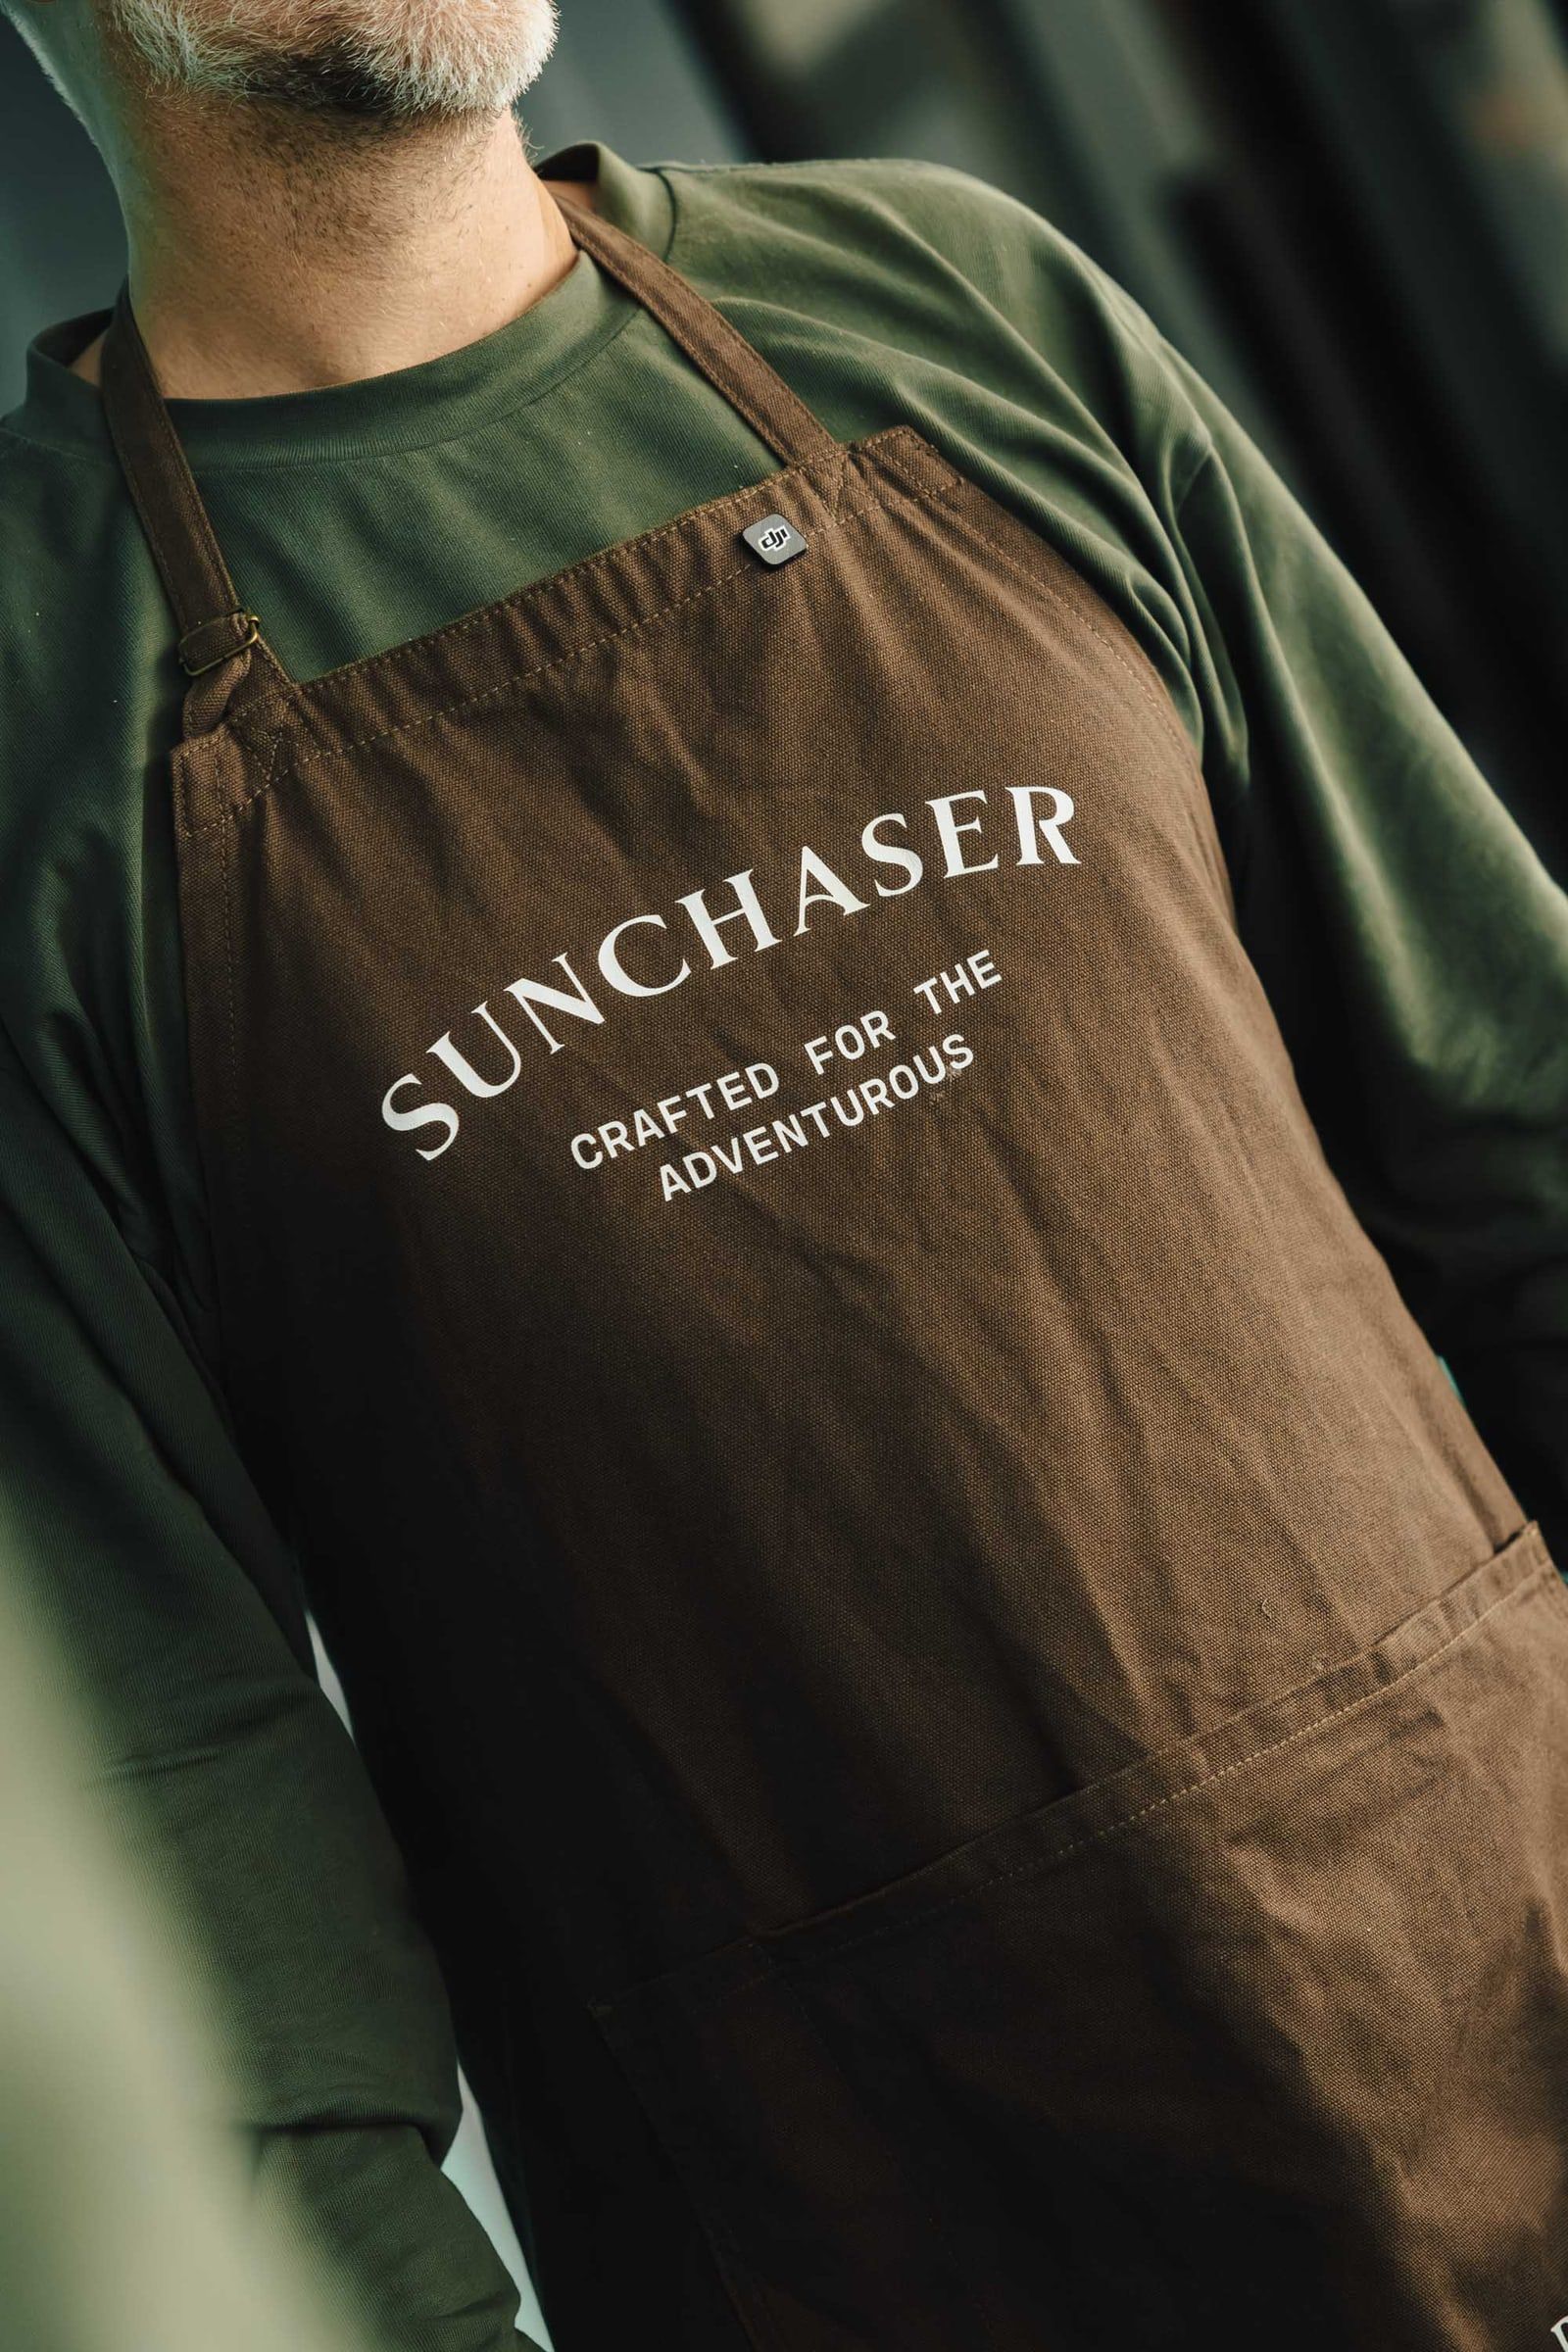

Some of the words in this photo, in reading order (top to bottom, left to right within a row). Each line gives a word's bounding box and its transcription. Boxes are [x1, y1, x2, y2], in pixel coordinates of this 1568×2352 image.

[381, 785, 1082, 1161] SUNCHASER
[570, 1062, 780, 1170] CRAFTED
[804, 1009, 897, 1075] FOR
[912, 949, 1003, 1015] THE
[660, 1033, 974, 1202] ADVENTUROUS
